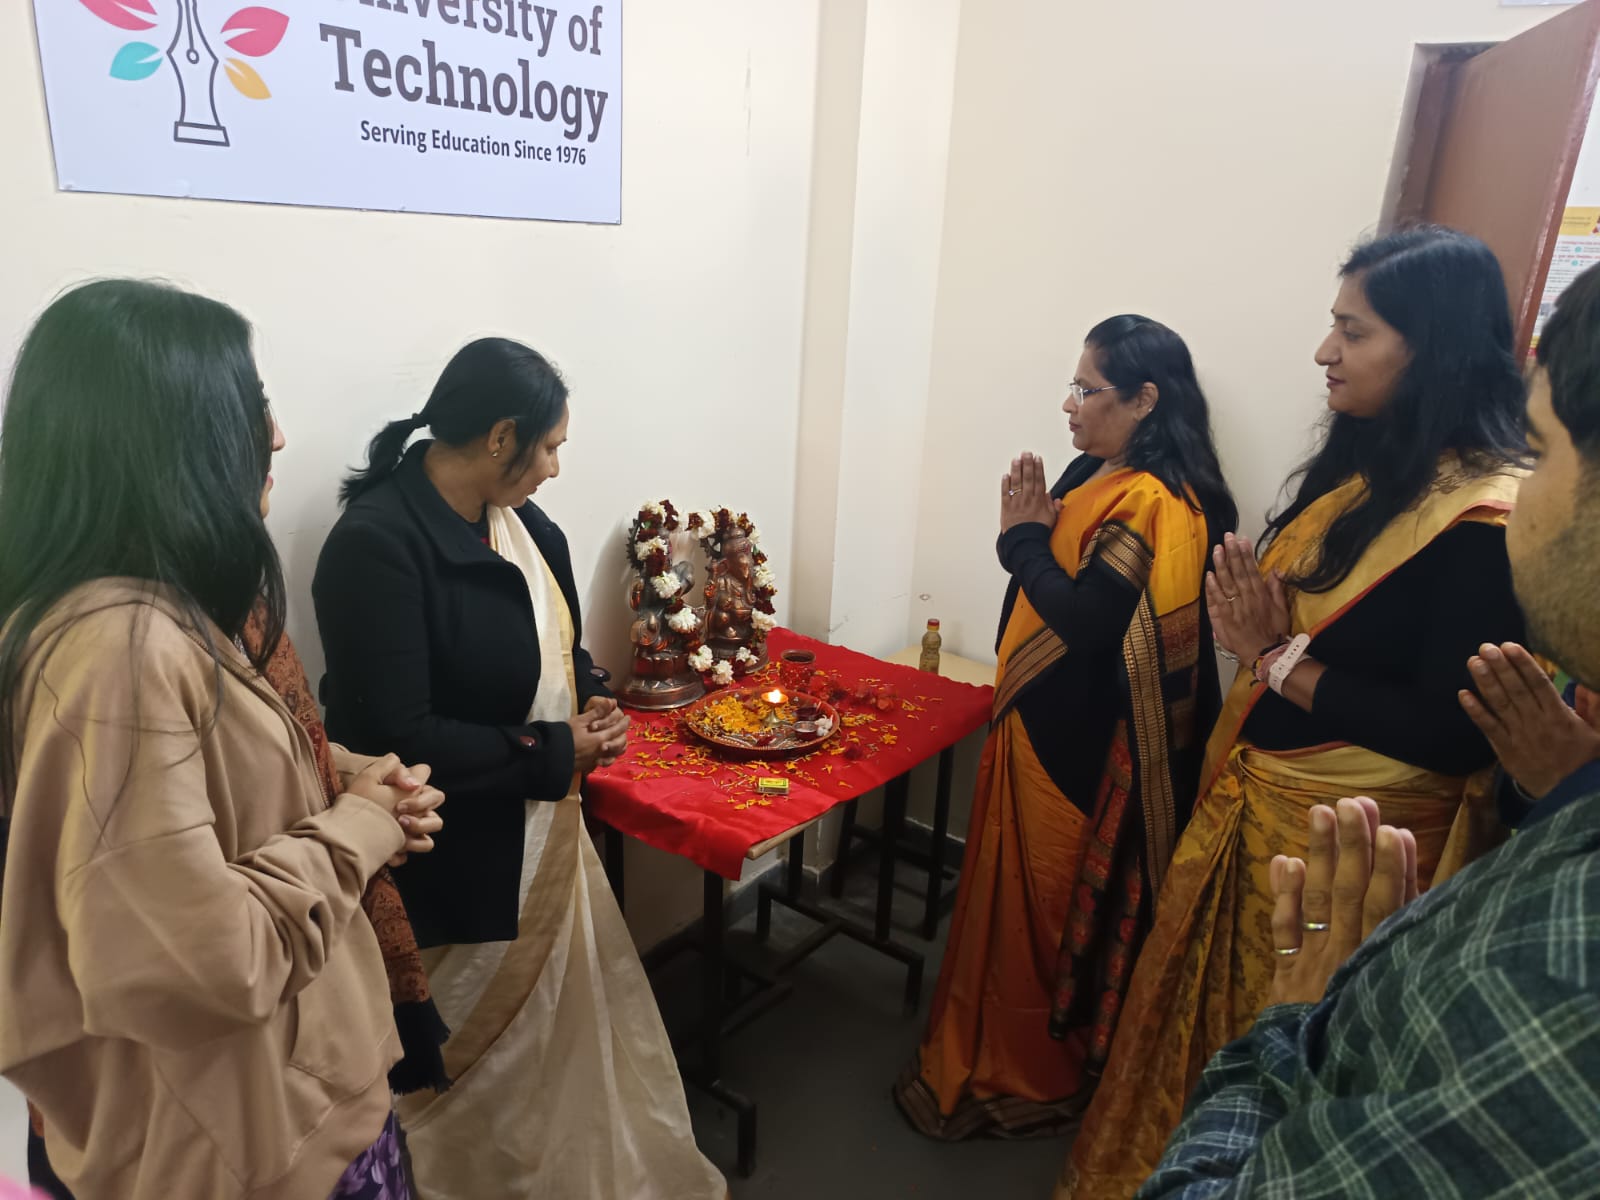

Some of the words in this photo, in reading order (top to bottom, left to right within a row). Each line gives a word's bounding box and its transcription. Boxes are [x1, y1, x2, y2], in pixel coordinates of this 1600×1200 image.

[568, 5, 603, 56] of
[319, 22, 609, 143] Technology
[360, 119, 427, 154] Serving
[431, 129, 510, 157] Education
[514, 139, 552, 162] Since
[555, 145, 587, 166] 1976
